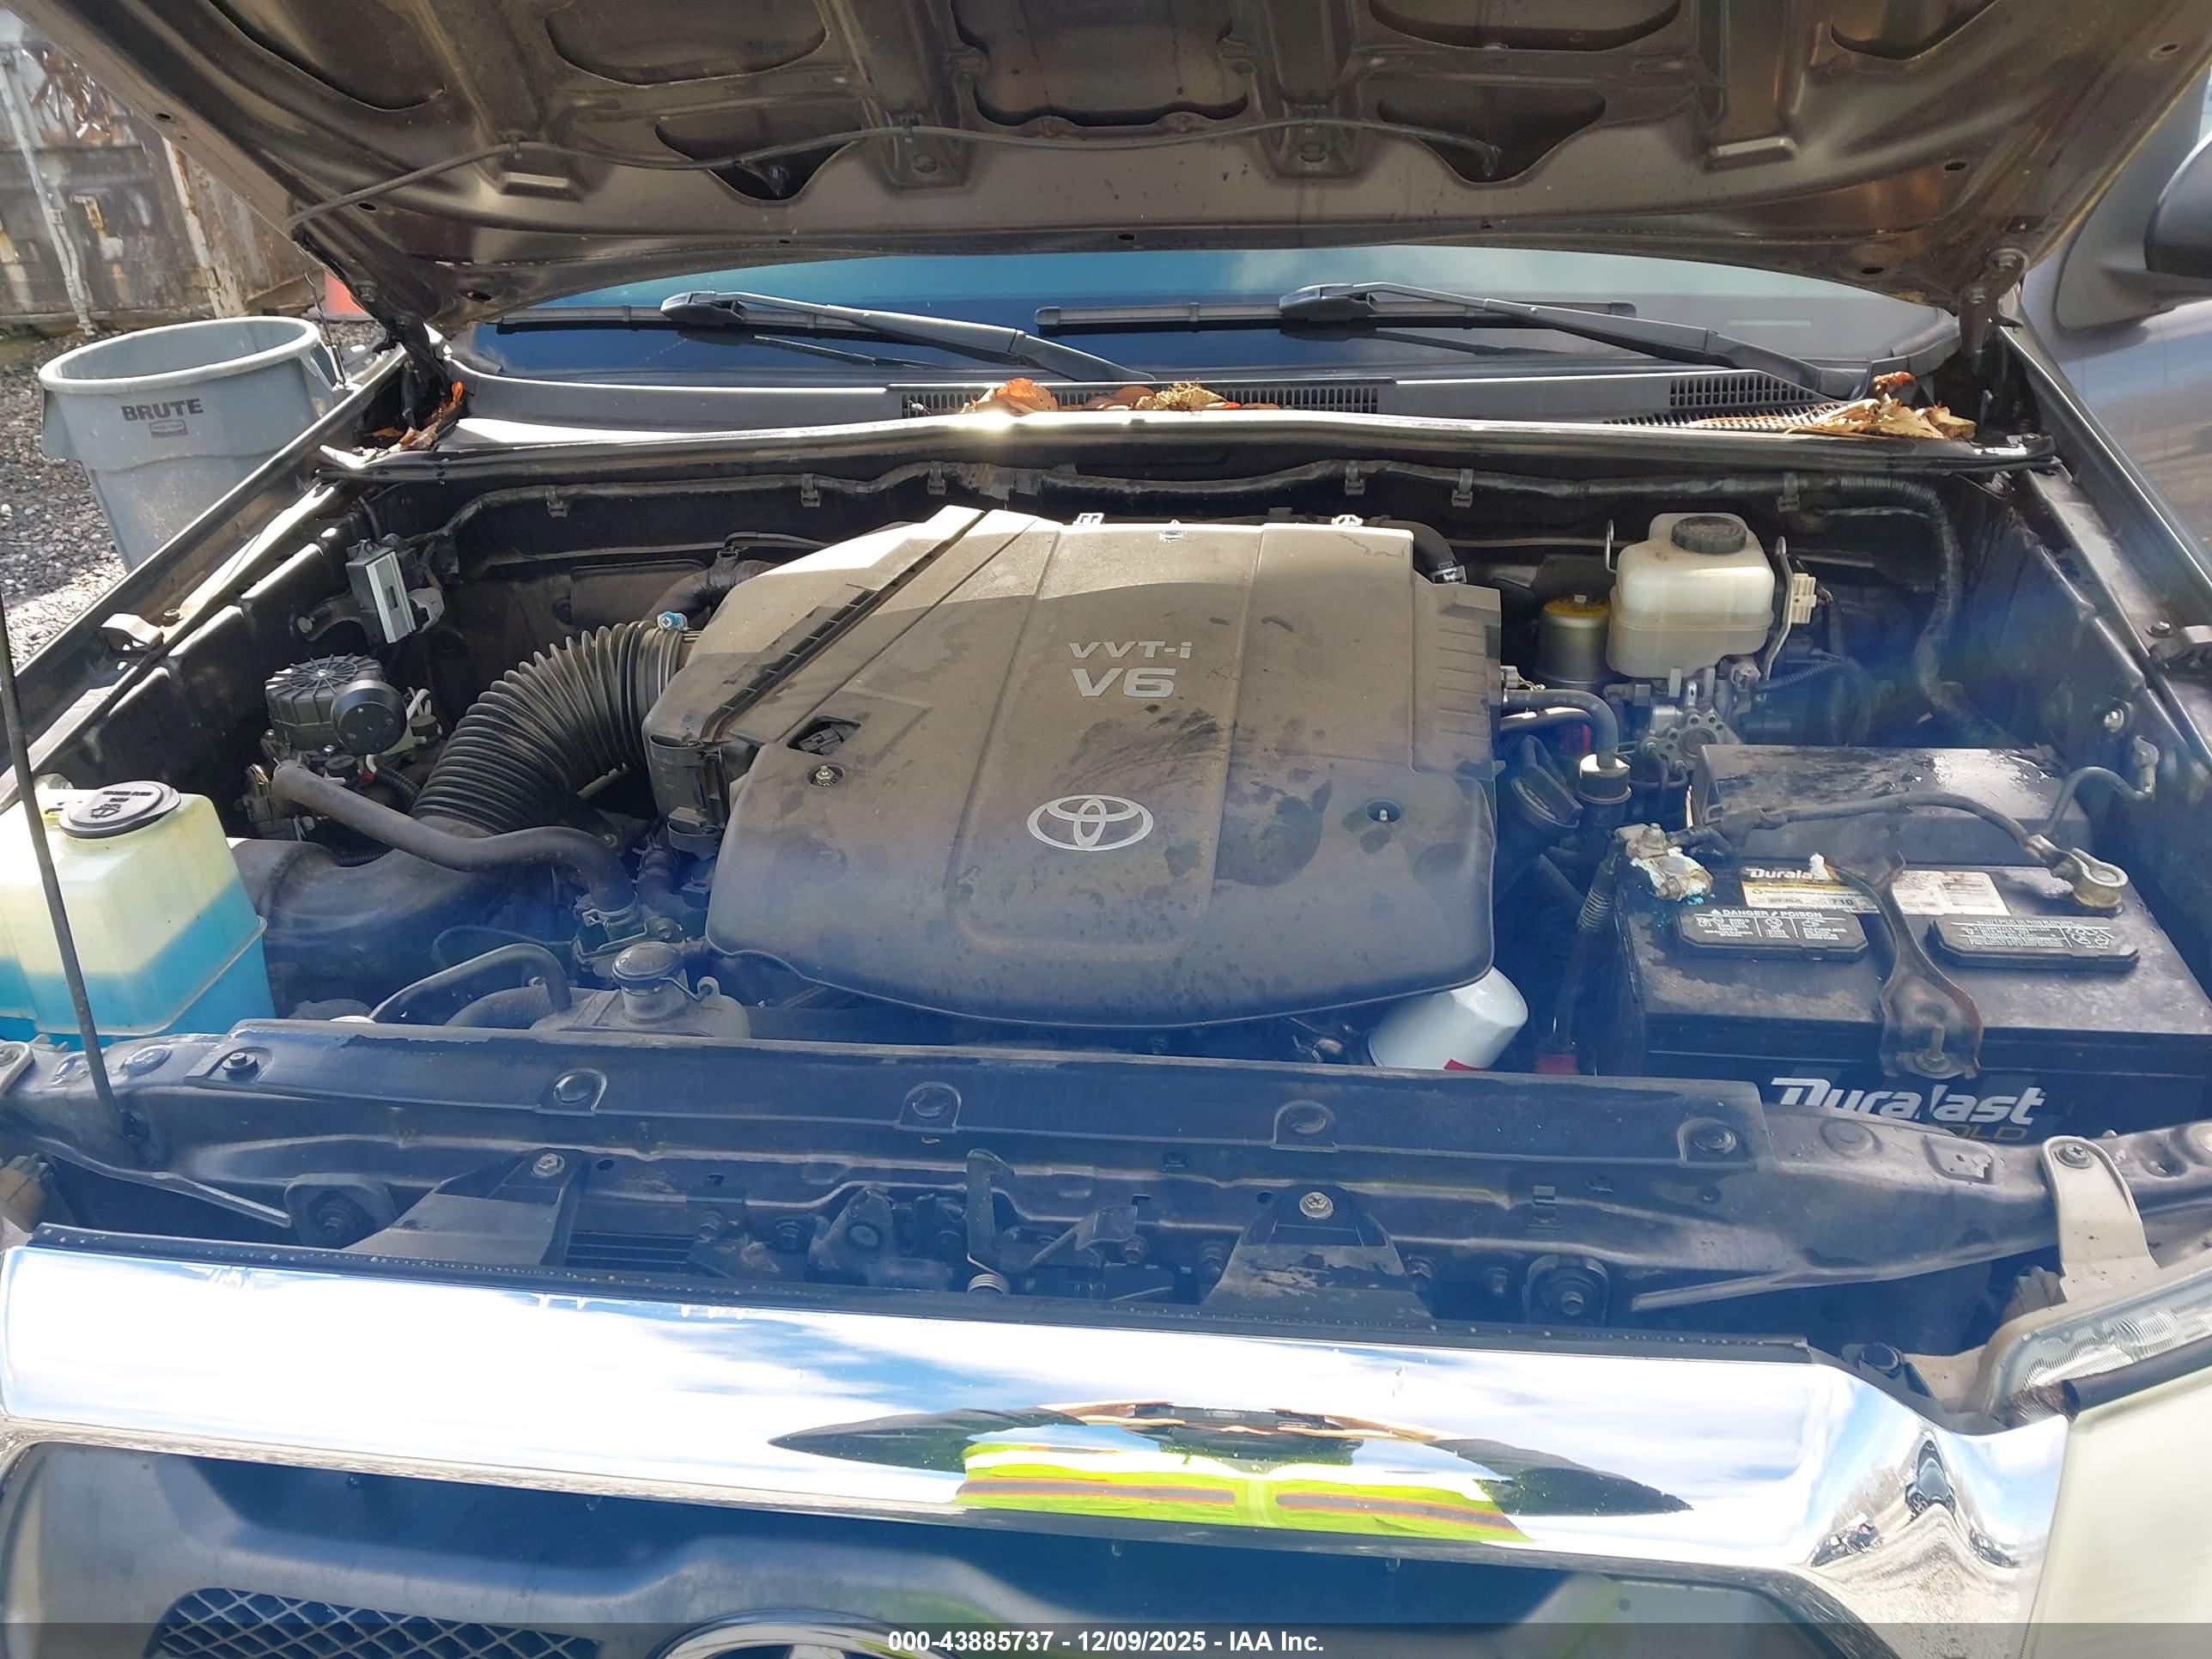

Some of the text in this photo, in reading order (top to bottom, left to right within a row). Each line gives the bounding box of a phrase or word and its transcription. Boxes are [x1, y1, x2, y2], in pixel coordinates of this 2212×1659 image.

[121, 398, 204, 421] BRUTE
[1068, 641, 1193, 659] VVT-i
[1071, 667, 1176, 697] V6
[1746, 868, 1814, 879] Durala
[1723, 908, 1769, 918] DANGER
[1771, 1077, 2047, 1125] Duralast
[1943, 1124, 2027, 1142] OLD
